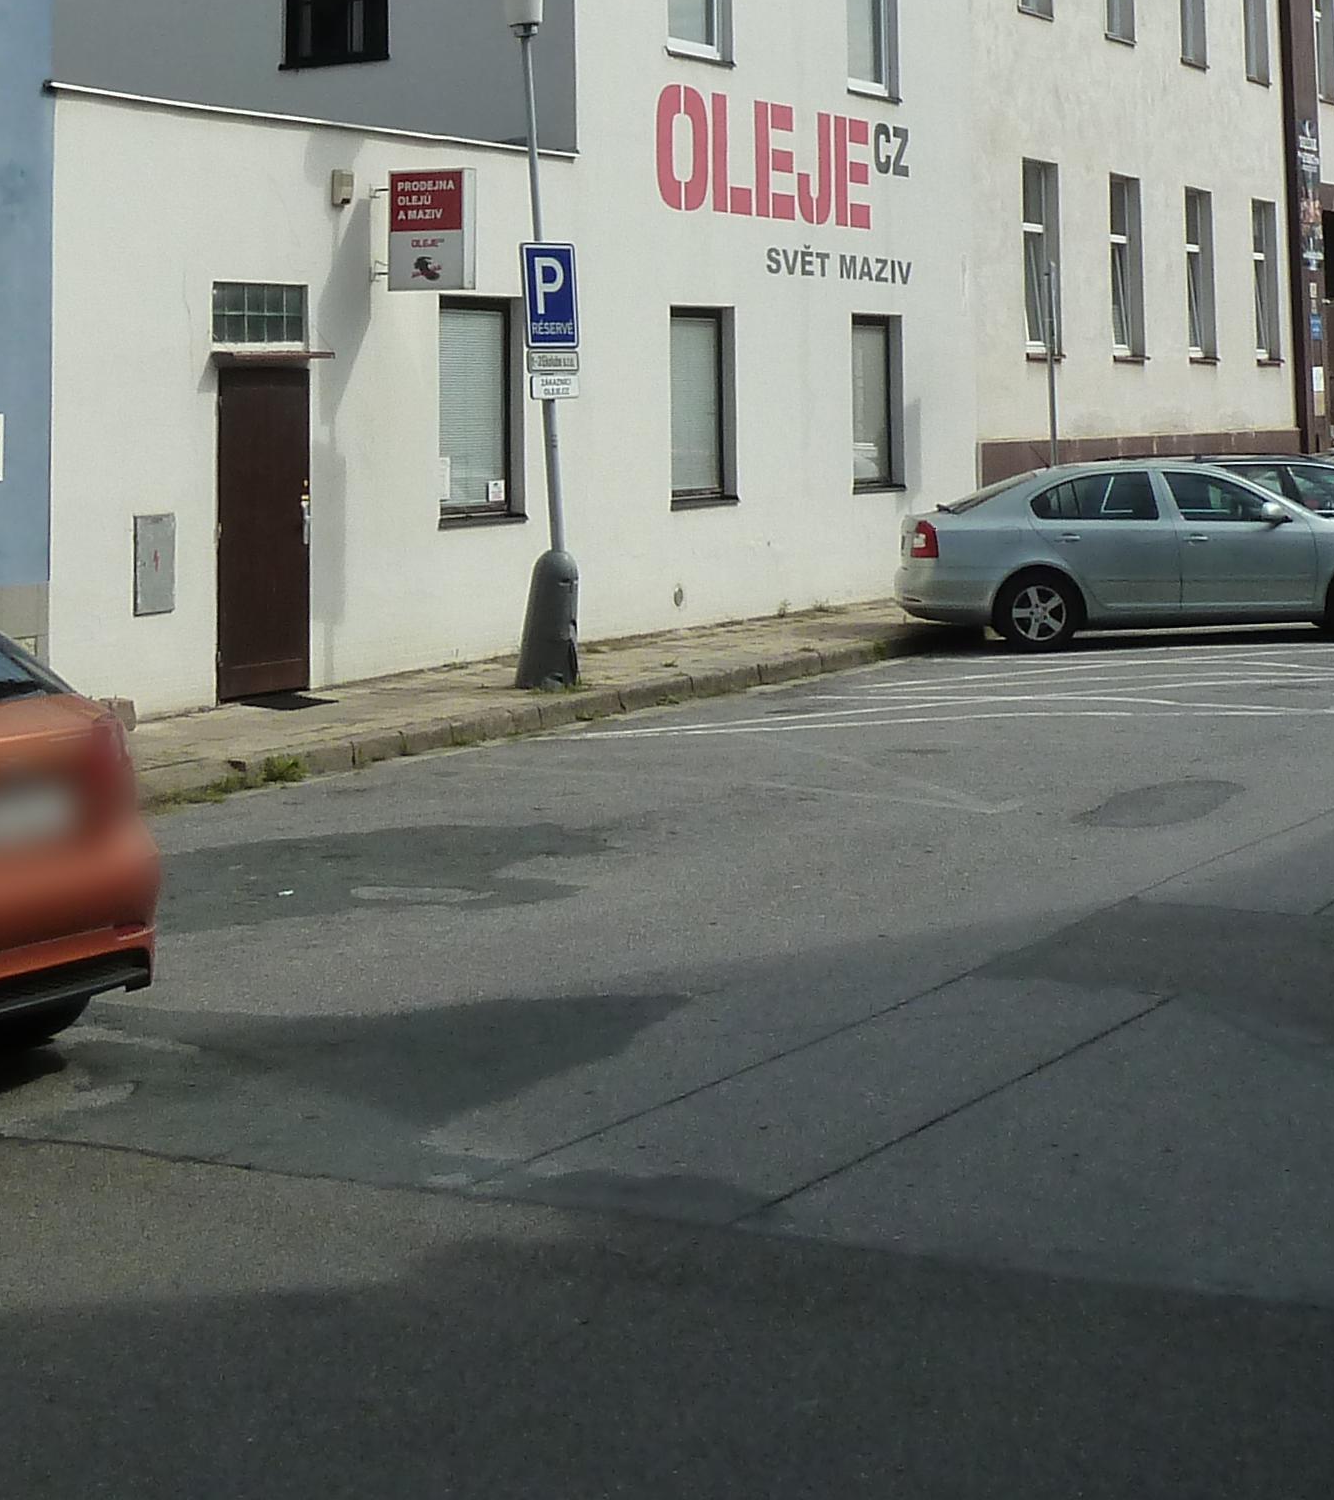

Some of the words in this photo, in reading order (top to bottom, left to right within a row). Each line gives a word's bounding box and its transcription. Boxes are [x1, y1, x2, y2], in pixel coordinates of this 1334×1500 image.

[655, 83, 871, 230] OLEJE
[873, 121, 910, 178] CZ
[397, 180, 455, 192] PRODEJNA
[397, 210, 406, 221] A
[407, 208, 443, 220] MAZIV
[766, 244, 830, 277] SVĚT
[839, 254, 912, 285] MAZIV
[534, 257, 564, 315] P
[532, 319, 574, 335] RÉSERVÉ
